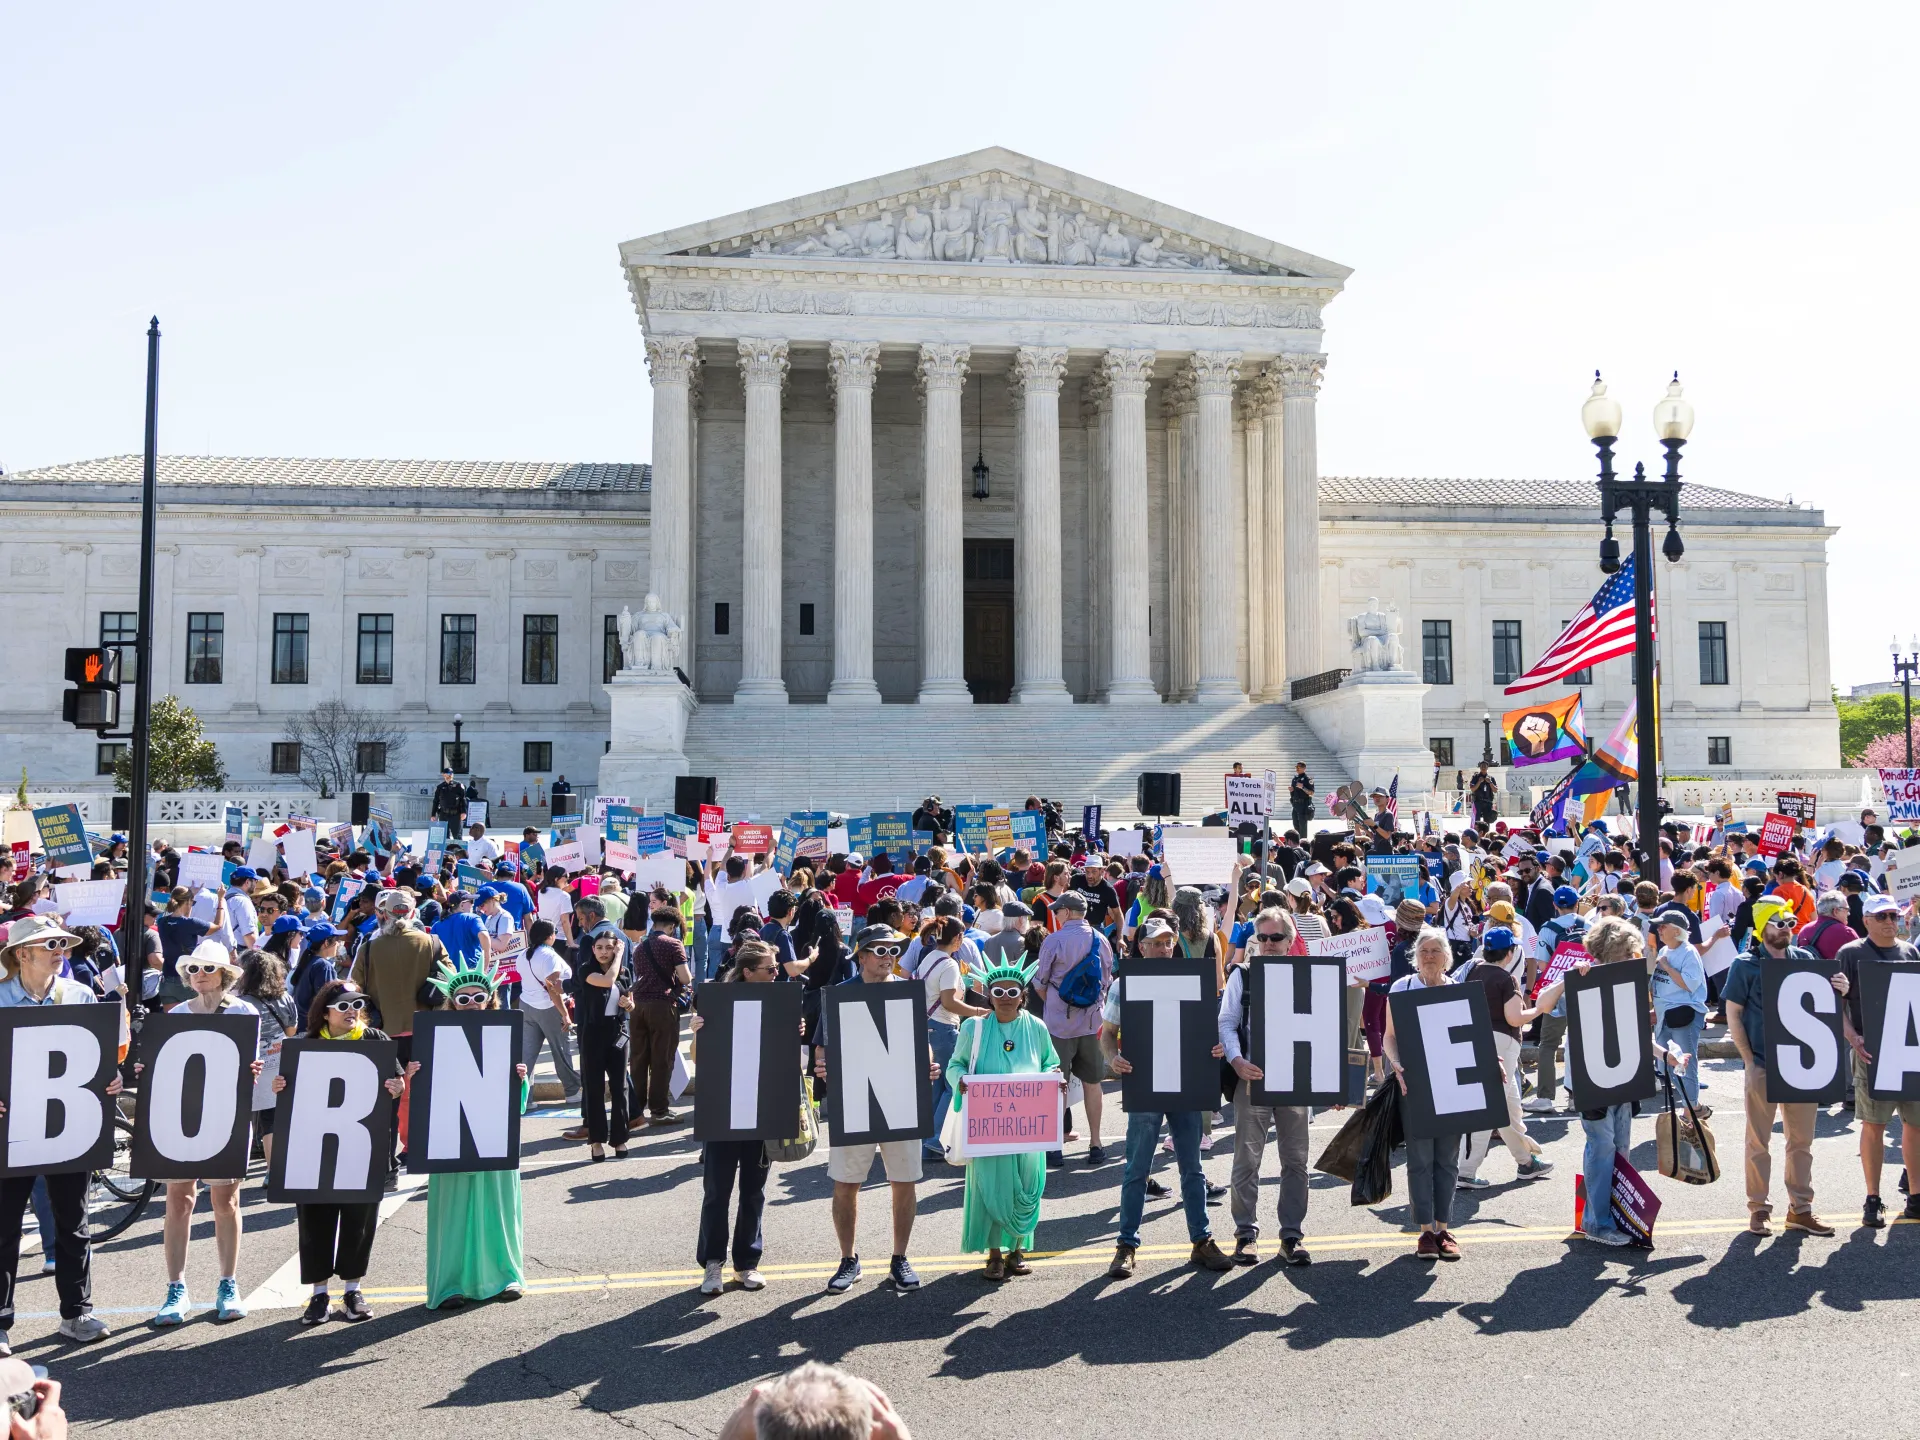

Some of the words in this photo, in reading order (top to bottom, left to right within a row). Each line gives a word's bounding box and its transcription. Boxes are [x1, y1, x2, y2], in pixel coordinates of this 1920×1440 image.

[868, 296, 927, 312] EQUAL
[940, 299, 1007, 315] JUSTICE
[1017, 302, 1081, 317] UNDER
[1086, 304, 1120, 318] LAW
[702, 813, 722, 824] BIRTH
[1230, 801, 1264, 816] ALL
[38, 814, 70, 828] FAMILIES
[42, 825, 68, 838] BELONG
[700, 822, 722, 832] RIGHT
[1765, 822, 1792, 836] BIRTH
[44, 834, 80, 848] TOGETHER.
[1762, 832, 1790, 845] RIGHT
[48, 848, 60, 857] NOT
[68, 844, 86, 854] CAGES.
[1320, 937, 1357, 955] NACIDO
[1564, 948, 1586, 958] Protect
[1346, 956, 1391, 974] DOUNIDENSE!
[1126, 975, 1201, 1093] T
[1264, 964, 1340, 1093] H
[1578, 982, 1641, 1089] U
[1777, 972, 1838, 1090] S
[731, 1001, 762, 1130] I
[839, 999, 918, 1134] N
[1417, 999, 1487, 1115] E
[8, 1024, 103, 1168] B
[150, 1030, 240, 1162] O
[428, 1025, 512, 1160] N
[994, 1102, 1002, 1112] IS
[1008, 1102, 1016, 1112] A
[284, 1051, 379, 1190] R
[968, 1114, 1048, 1138] BIRTHRIGHT
[1616, 1170, 1635, 1194] BELONG
[1632, 1190, 1646, 1210] HERE,
[1616, 1182, 1634, 1205] DEFEND
[1620, 1199, 1650, 1232] CITIZENSHIP
